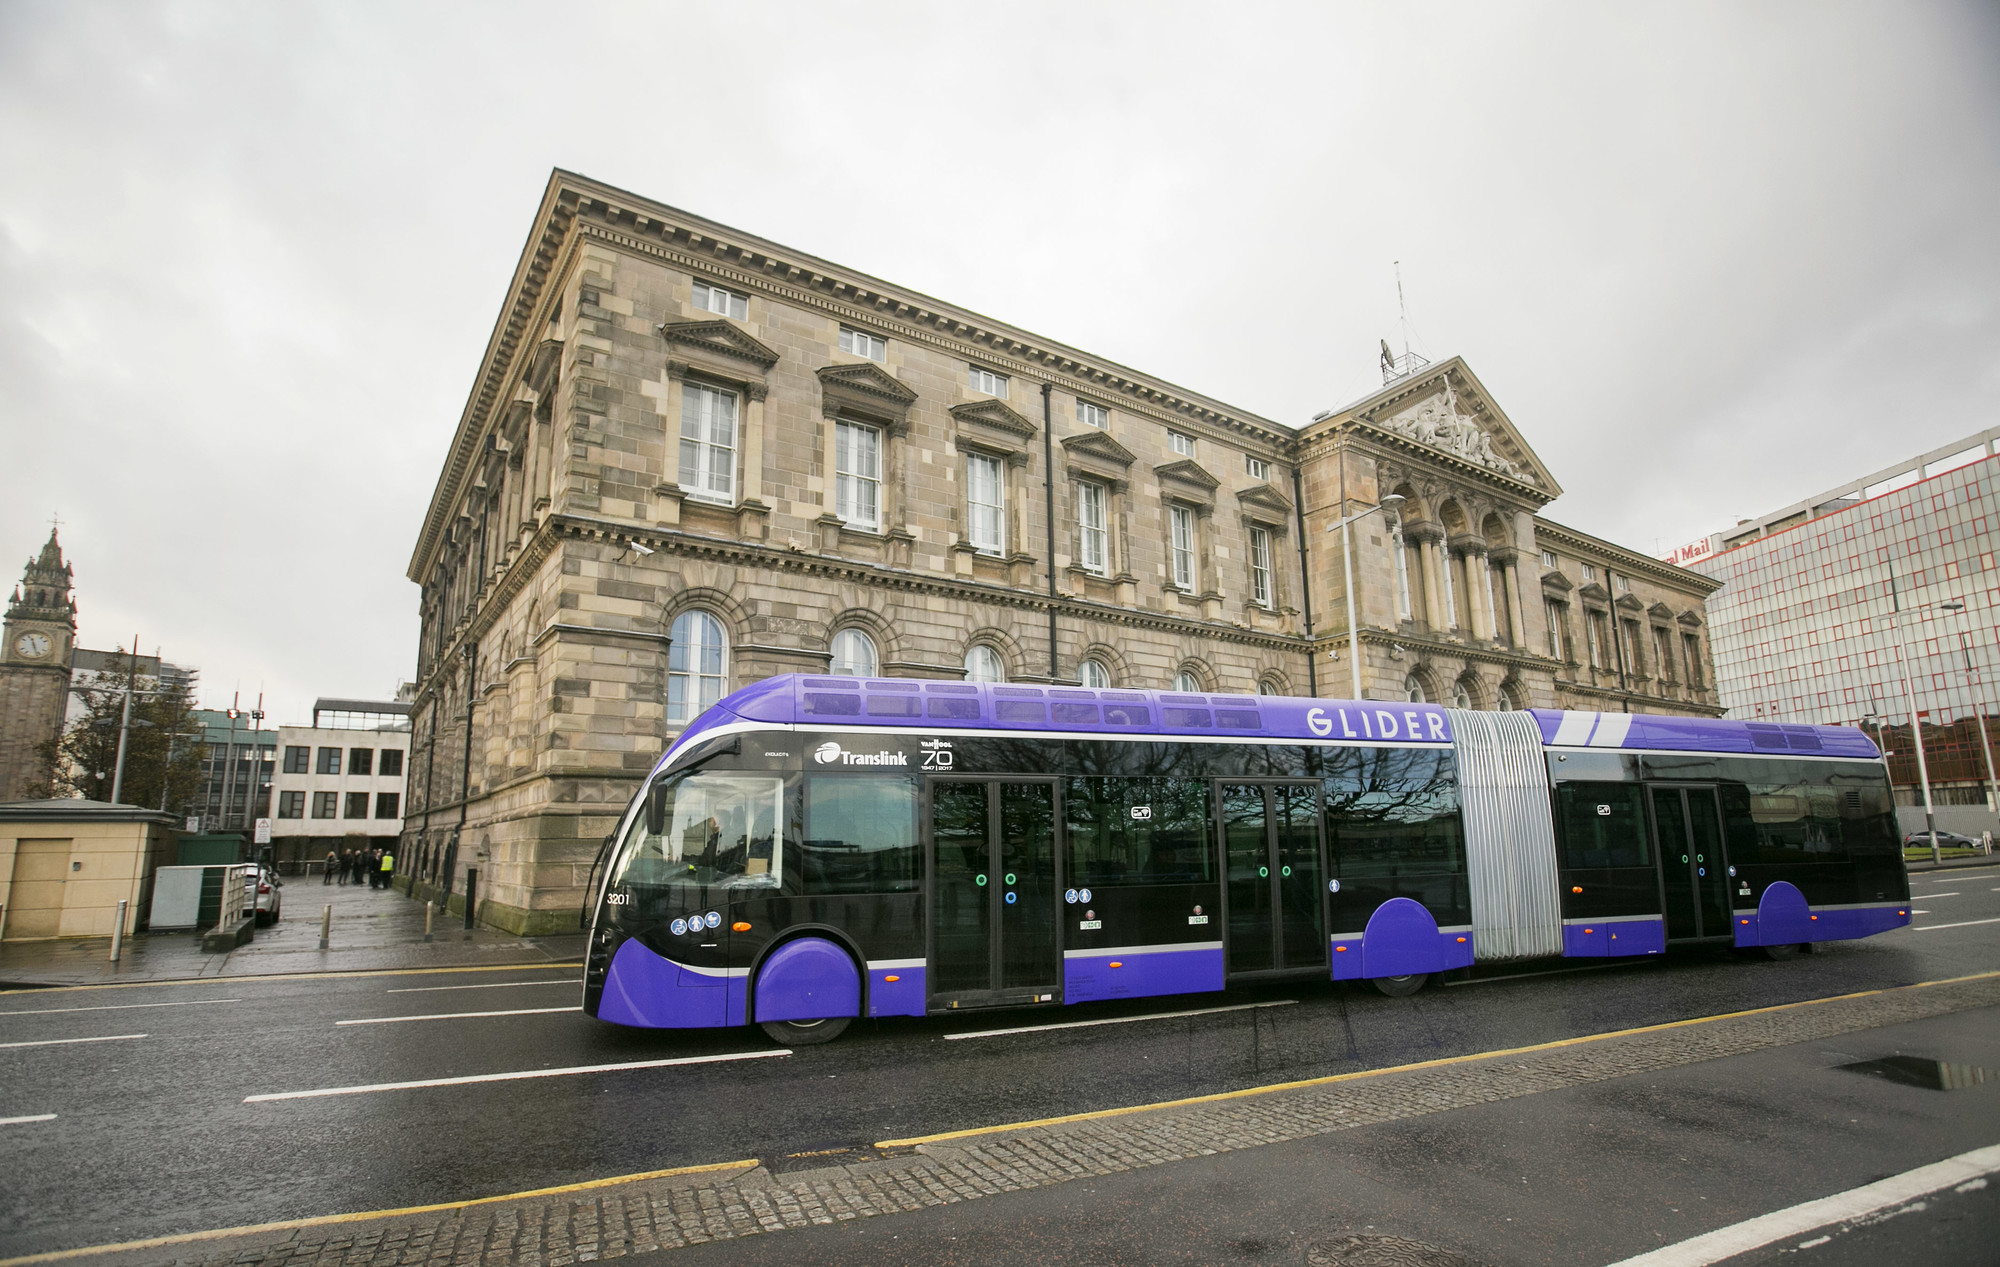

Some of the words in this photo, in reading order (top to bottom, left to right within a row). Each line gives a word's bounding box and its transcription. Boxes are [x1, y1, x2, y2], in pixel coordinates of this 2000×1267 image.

[1681, 537, 1710, 561] Mail
[1307, 708, 1447, 740] GLIDER
[840, 751, 908, 766] Translink
[920, 750, 953, 766] 70
[607, 893, 630, 905] 3201
